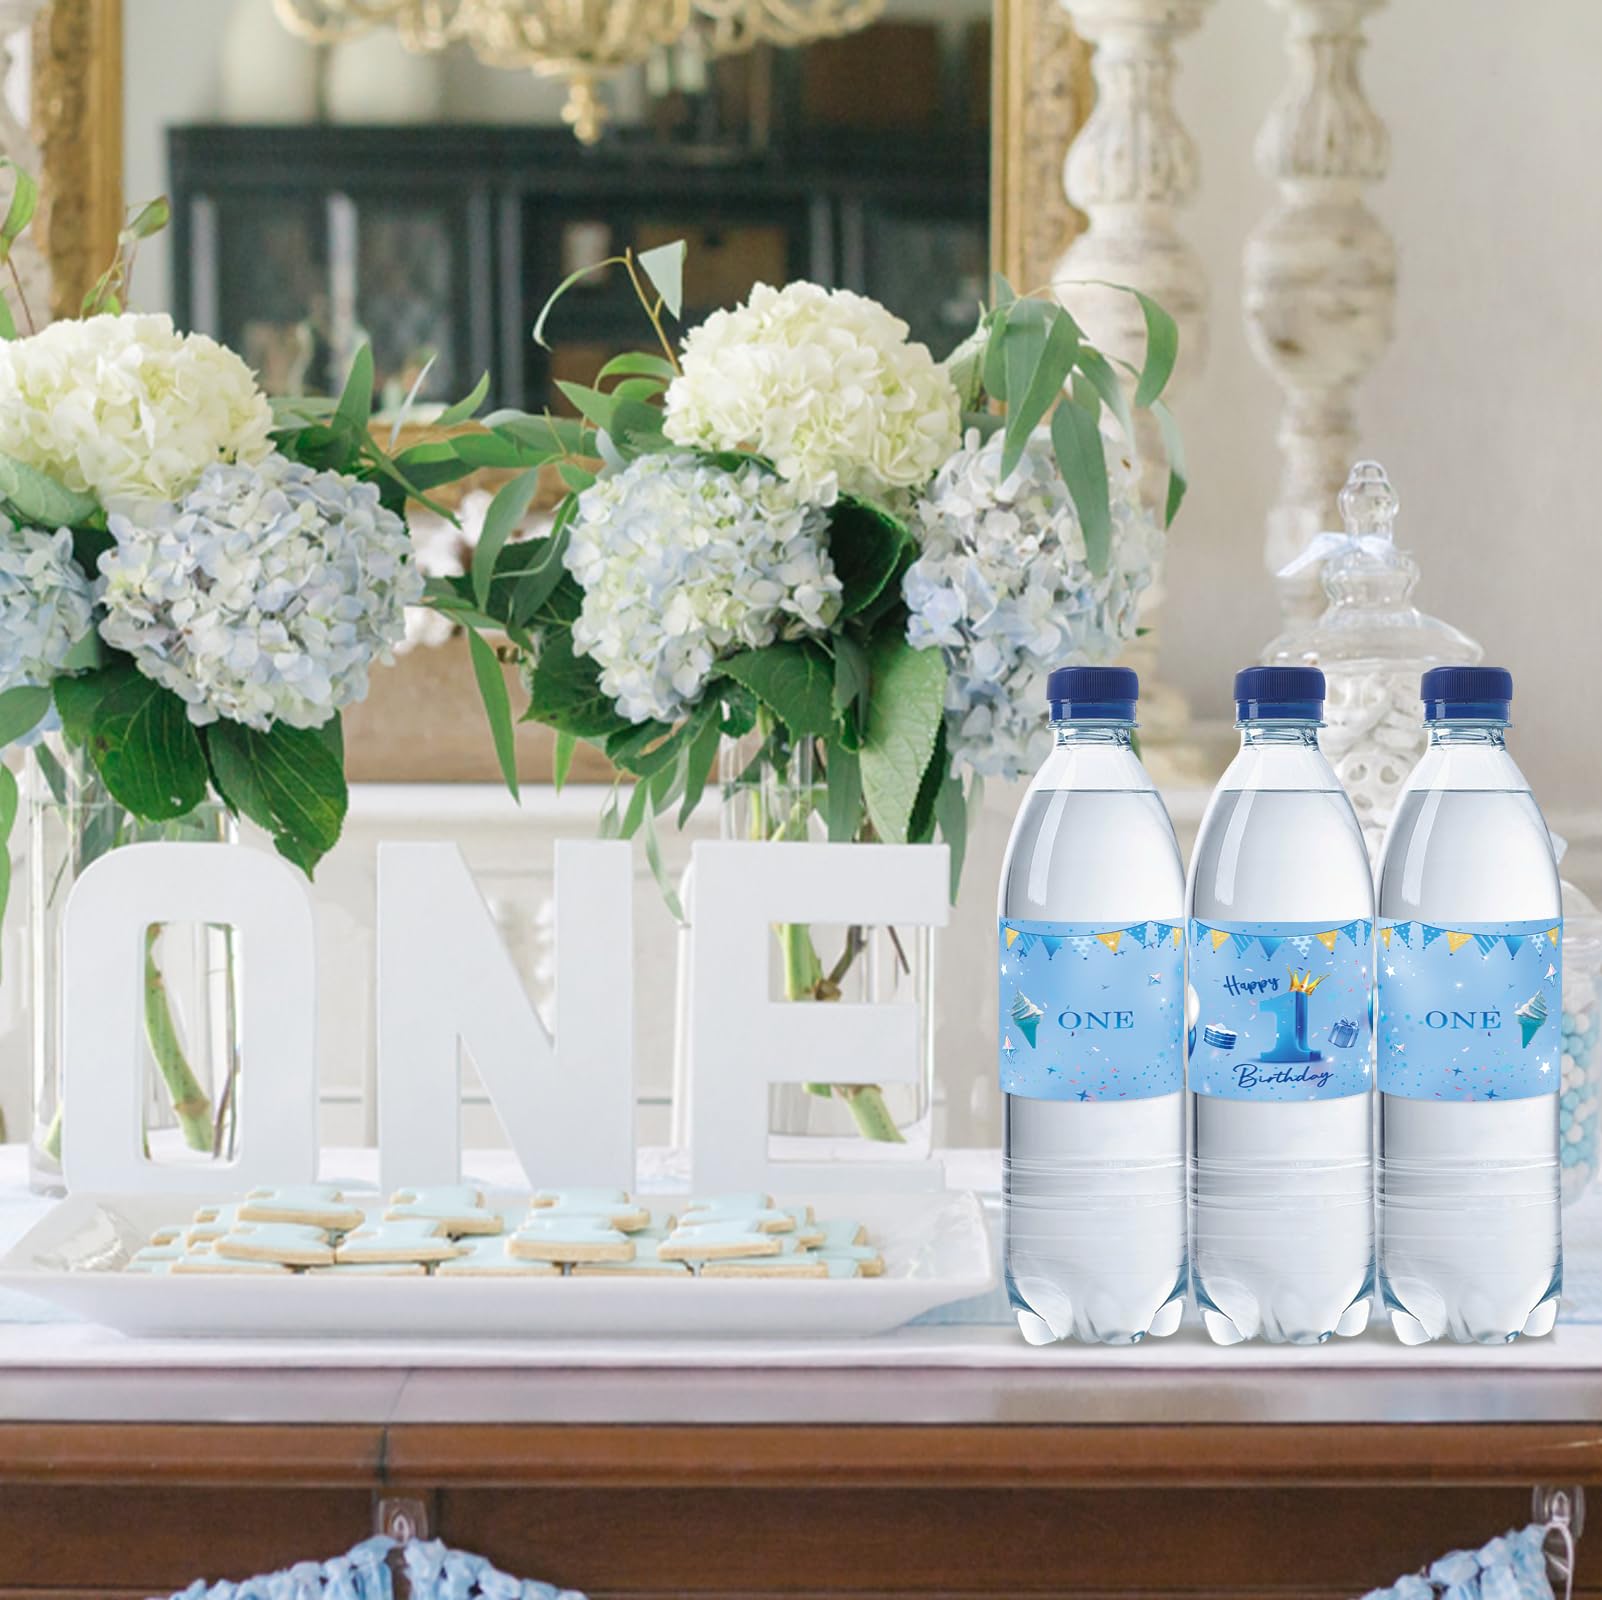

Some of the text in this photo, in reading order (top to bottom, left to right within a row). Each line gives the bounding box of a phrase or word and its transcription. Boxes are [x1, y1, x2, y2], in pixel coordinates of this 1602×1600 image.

[1223, 975, 1280, 996] Happy
[62, 839, 951, 1194] ONE
[1057, 1011, 1134, 1030] ONE
[1259, 991, 1322, 1063] 1
[1425, 1010, 1502, 1030] ONE
[1232, 1063, 1334, 1088] Birthday
